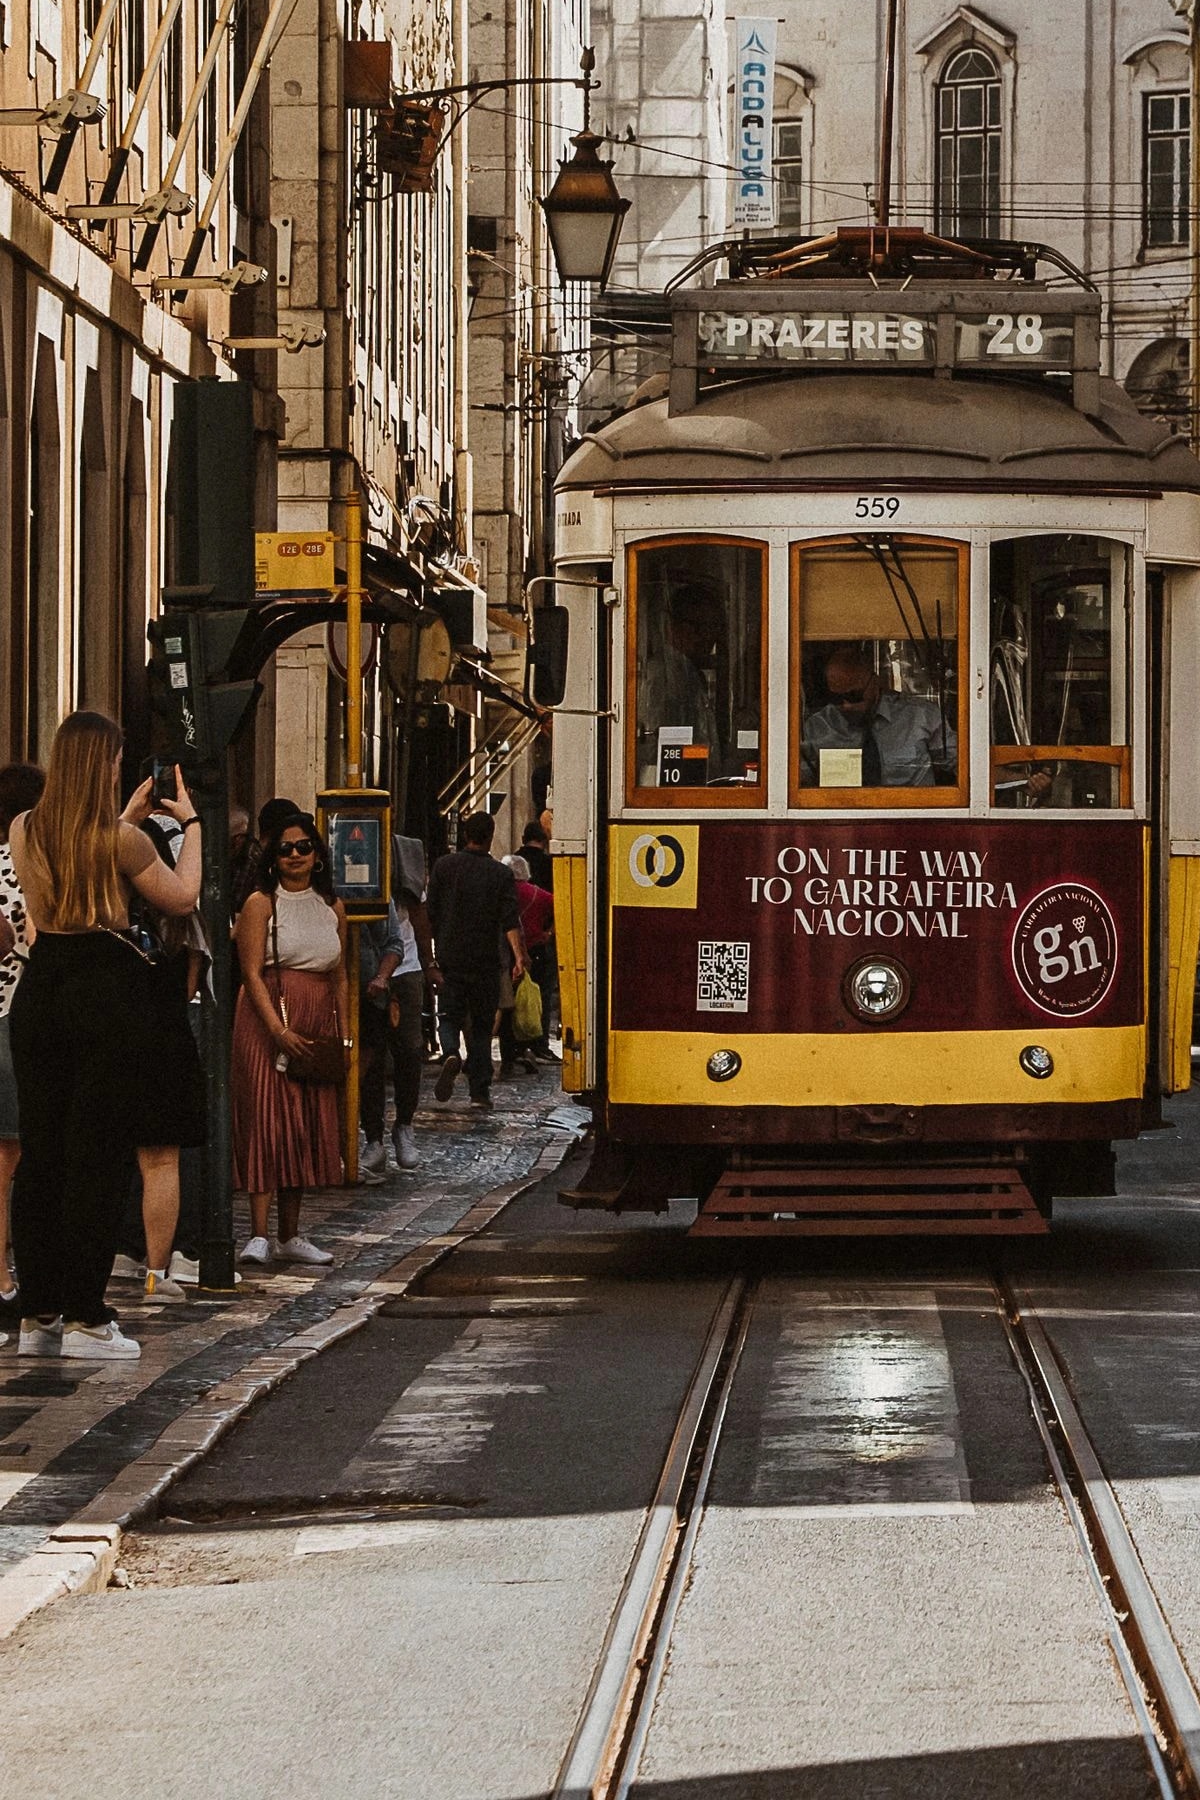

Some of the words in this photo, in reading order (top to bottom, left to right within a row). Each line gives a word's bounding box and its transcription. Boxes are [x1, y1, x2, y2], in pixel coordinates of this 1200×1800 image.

[741, 62, 766, 197] ANDALUSA
[726, 317, 924, 351] PRAZERES
[986, 314, 1044, 354] 28
[855, 497, 900, 519] 559
[281, 545, 297, 554] 12E
[306, 544, 322, 553] 28E
[663, 749, 681, 759] 28E
[663, 768, 681, 783] 10
[777, 847, 830, 875] ON
[841, 848, 907, 876] THE
[919, 851, 989, 878] WAY
[745, 876, 793, 904] TO
[803, 877, 1018, 908] GARRAFEIRA
[793, 908, 969, 938] NACIONAL
[1033, 923, 1103, 984] gn
